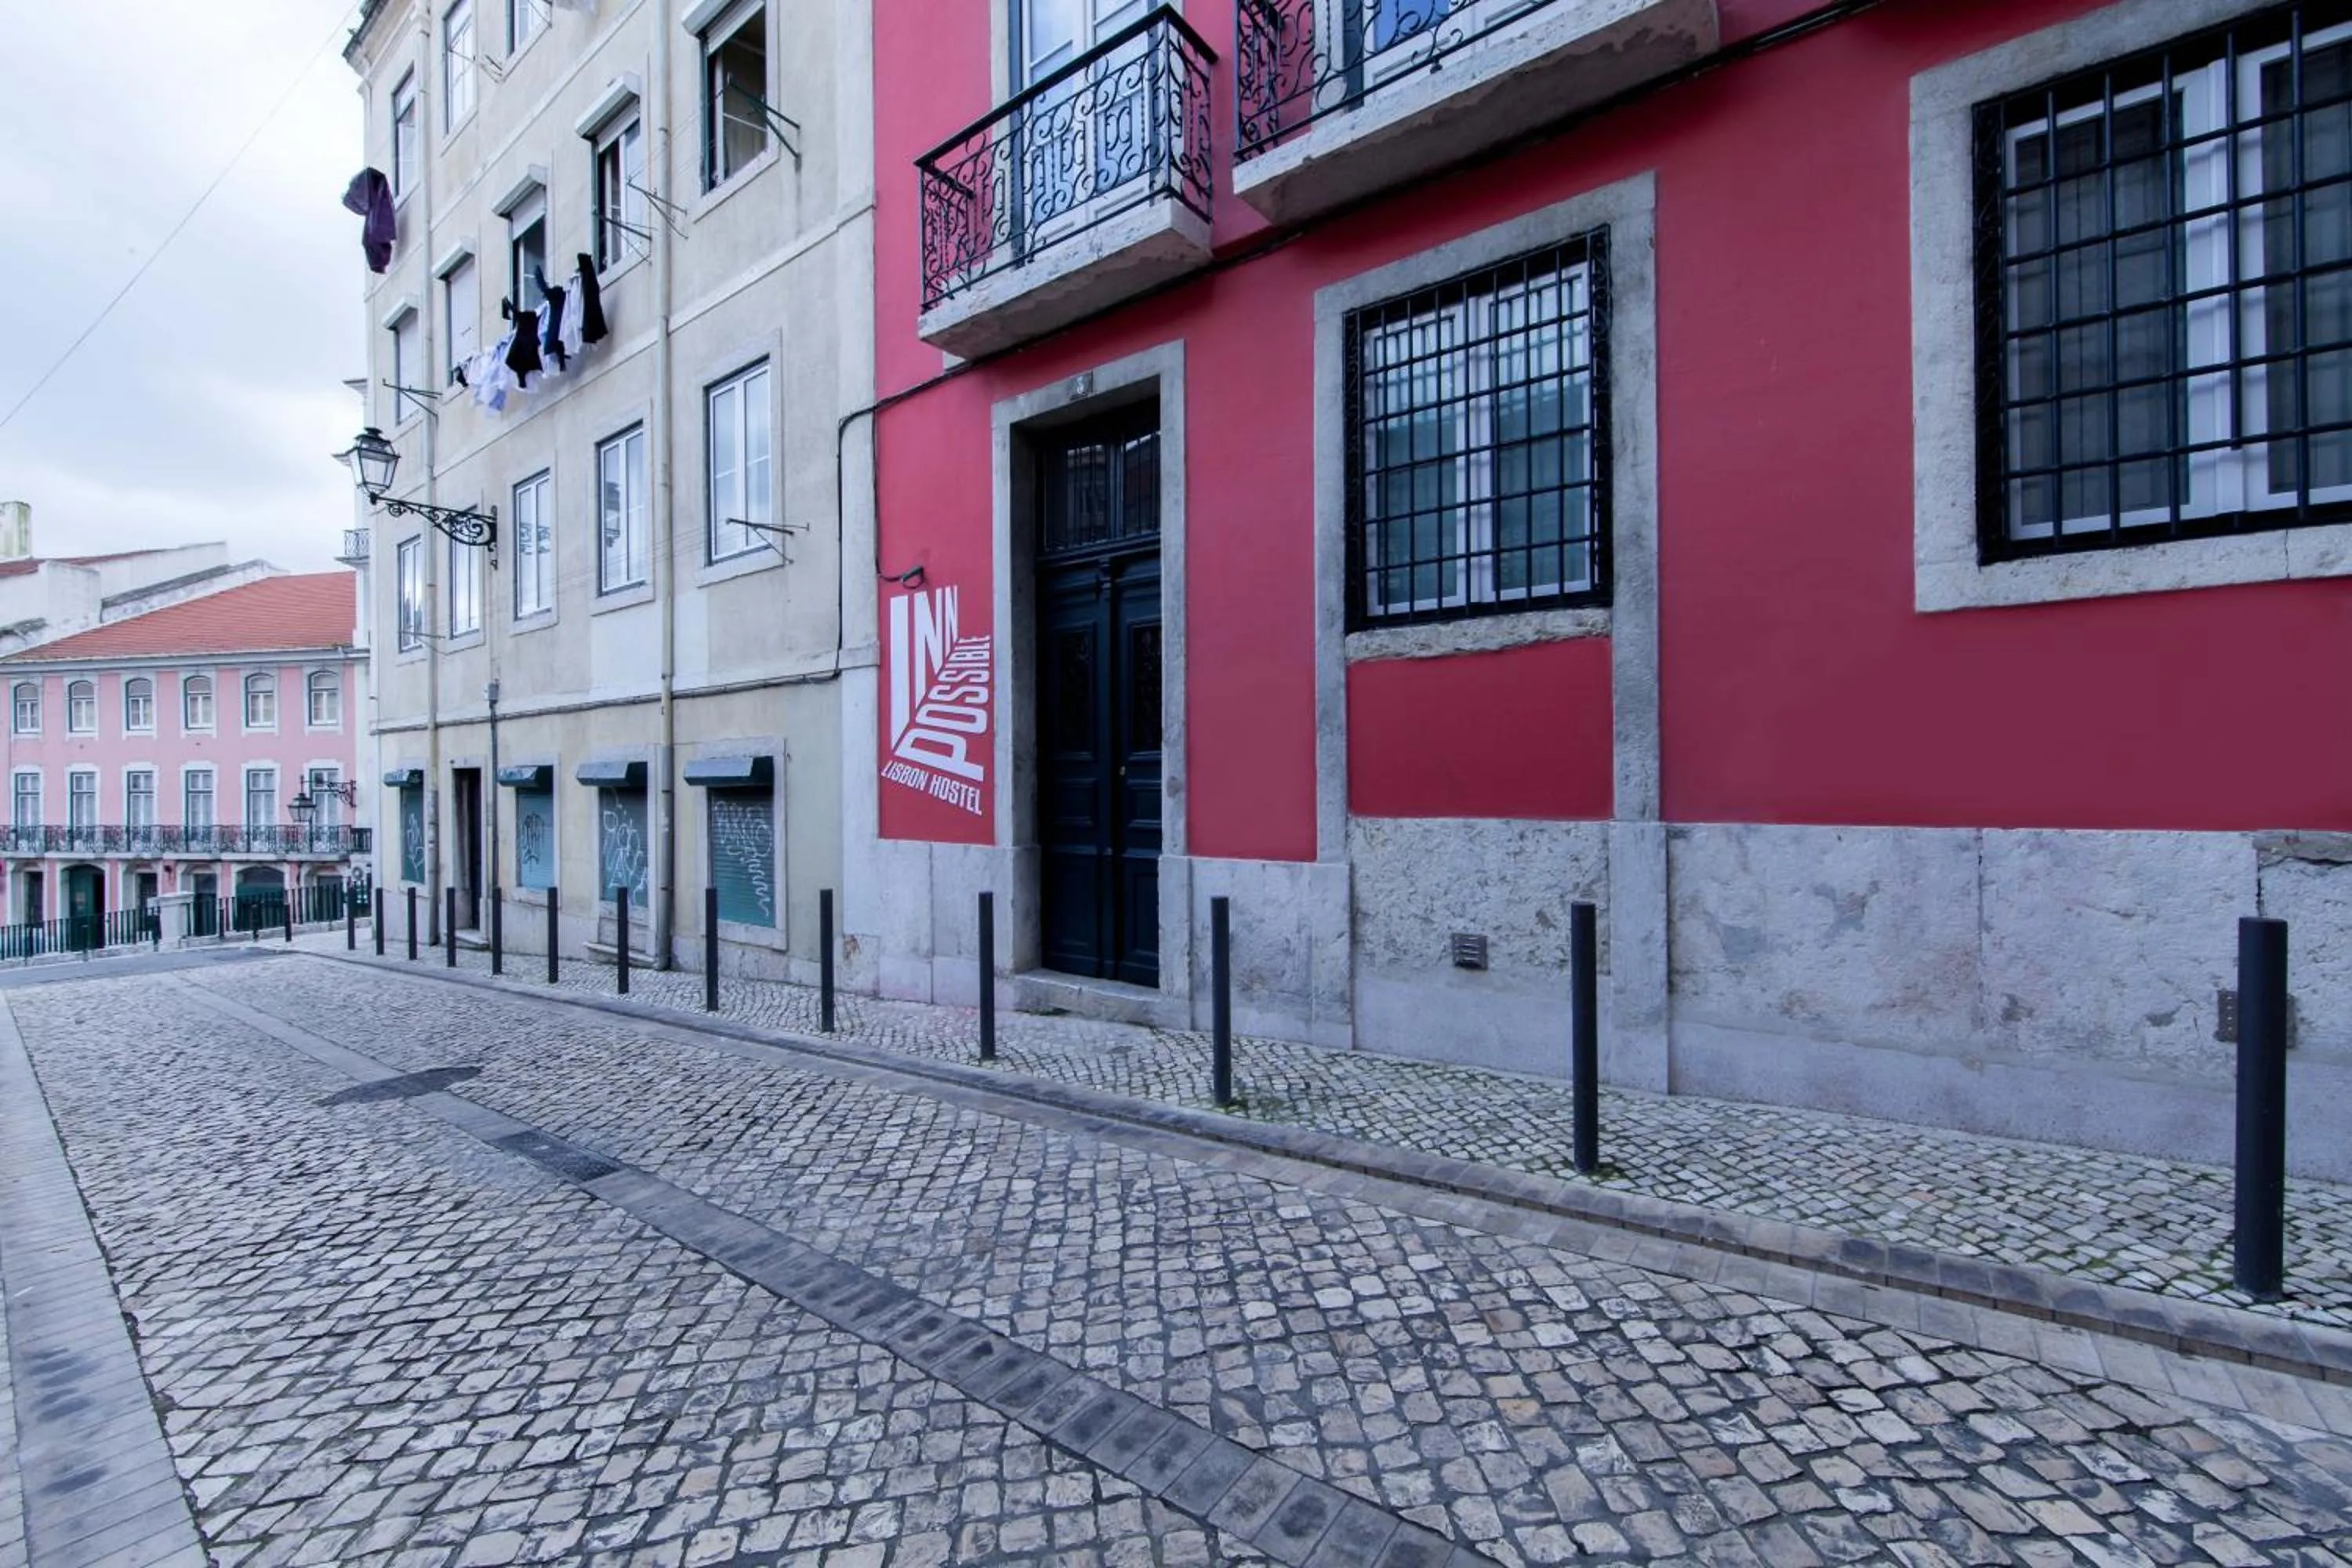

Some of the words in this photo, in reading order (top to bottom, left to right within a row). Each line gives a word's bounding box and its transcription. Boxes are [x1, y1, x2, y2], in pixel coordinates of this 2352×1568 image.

[890, 585, 958, 750] INN
[894, 634, 992, 782] POSSIBLE
[880, 759, 929, 792] LISBON
[929, 774, 983, 816] HOSTEL
